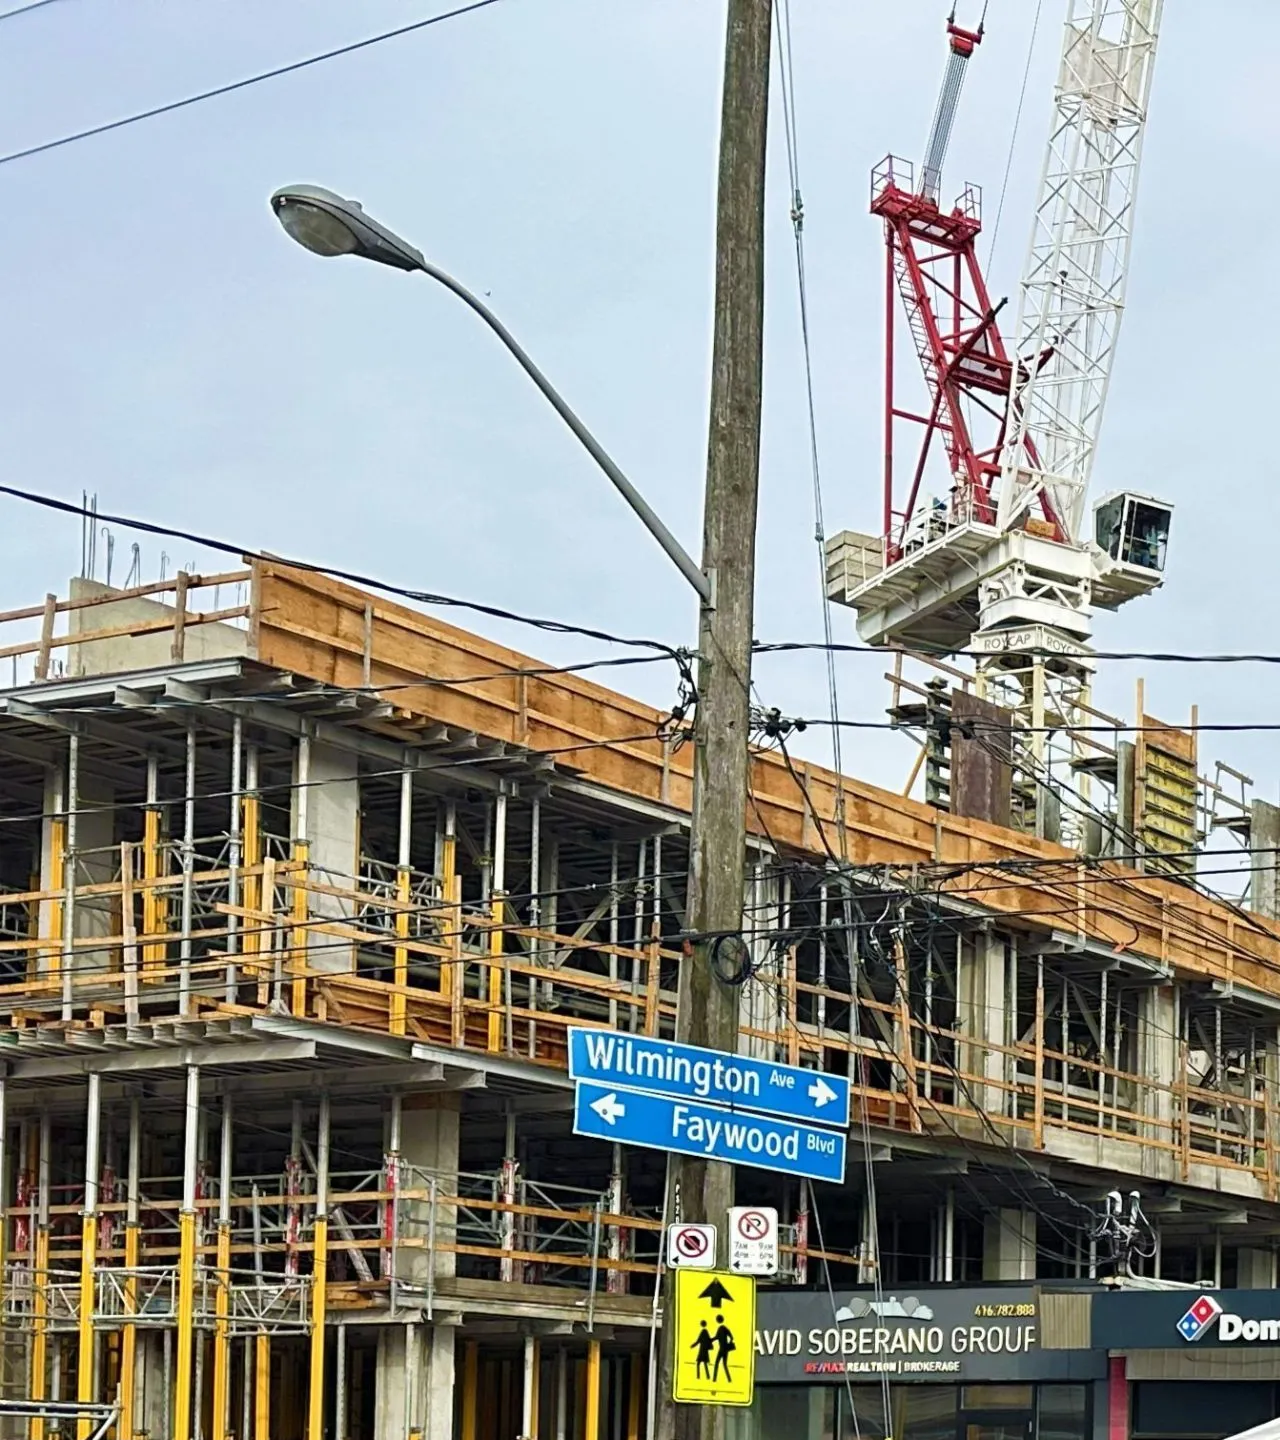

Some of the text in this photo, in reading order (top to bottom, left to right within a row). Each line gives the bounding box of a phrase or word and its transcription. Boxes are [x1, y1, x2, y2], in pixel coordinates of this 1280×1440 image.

[984, 633, 1031, 650] ROYCAP
[1046, 636, 1085, 655] ROYCA
[585, 1034, 796, 1096] Wilmington Ave
[672, 1105, 835, 1160] Faywood Blvd
[753, 1329, 801, 1355] AVID
[808, 1326, 943, 1355] SOBERANO
[804, 1361, 845, 1373] RE/MAX
[846, 1361, 897, 1372] REALTRON
[904, 1361, 960, 1372] BROKERAGE
